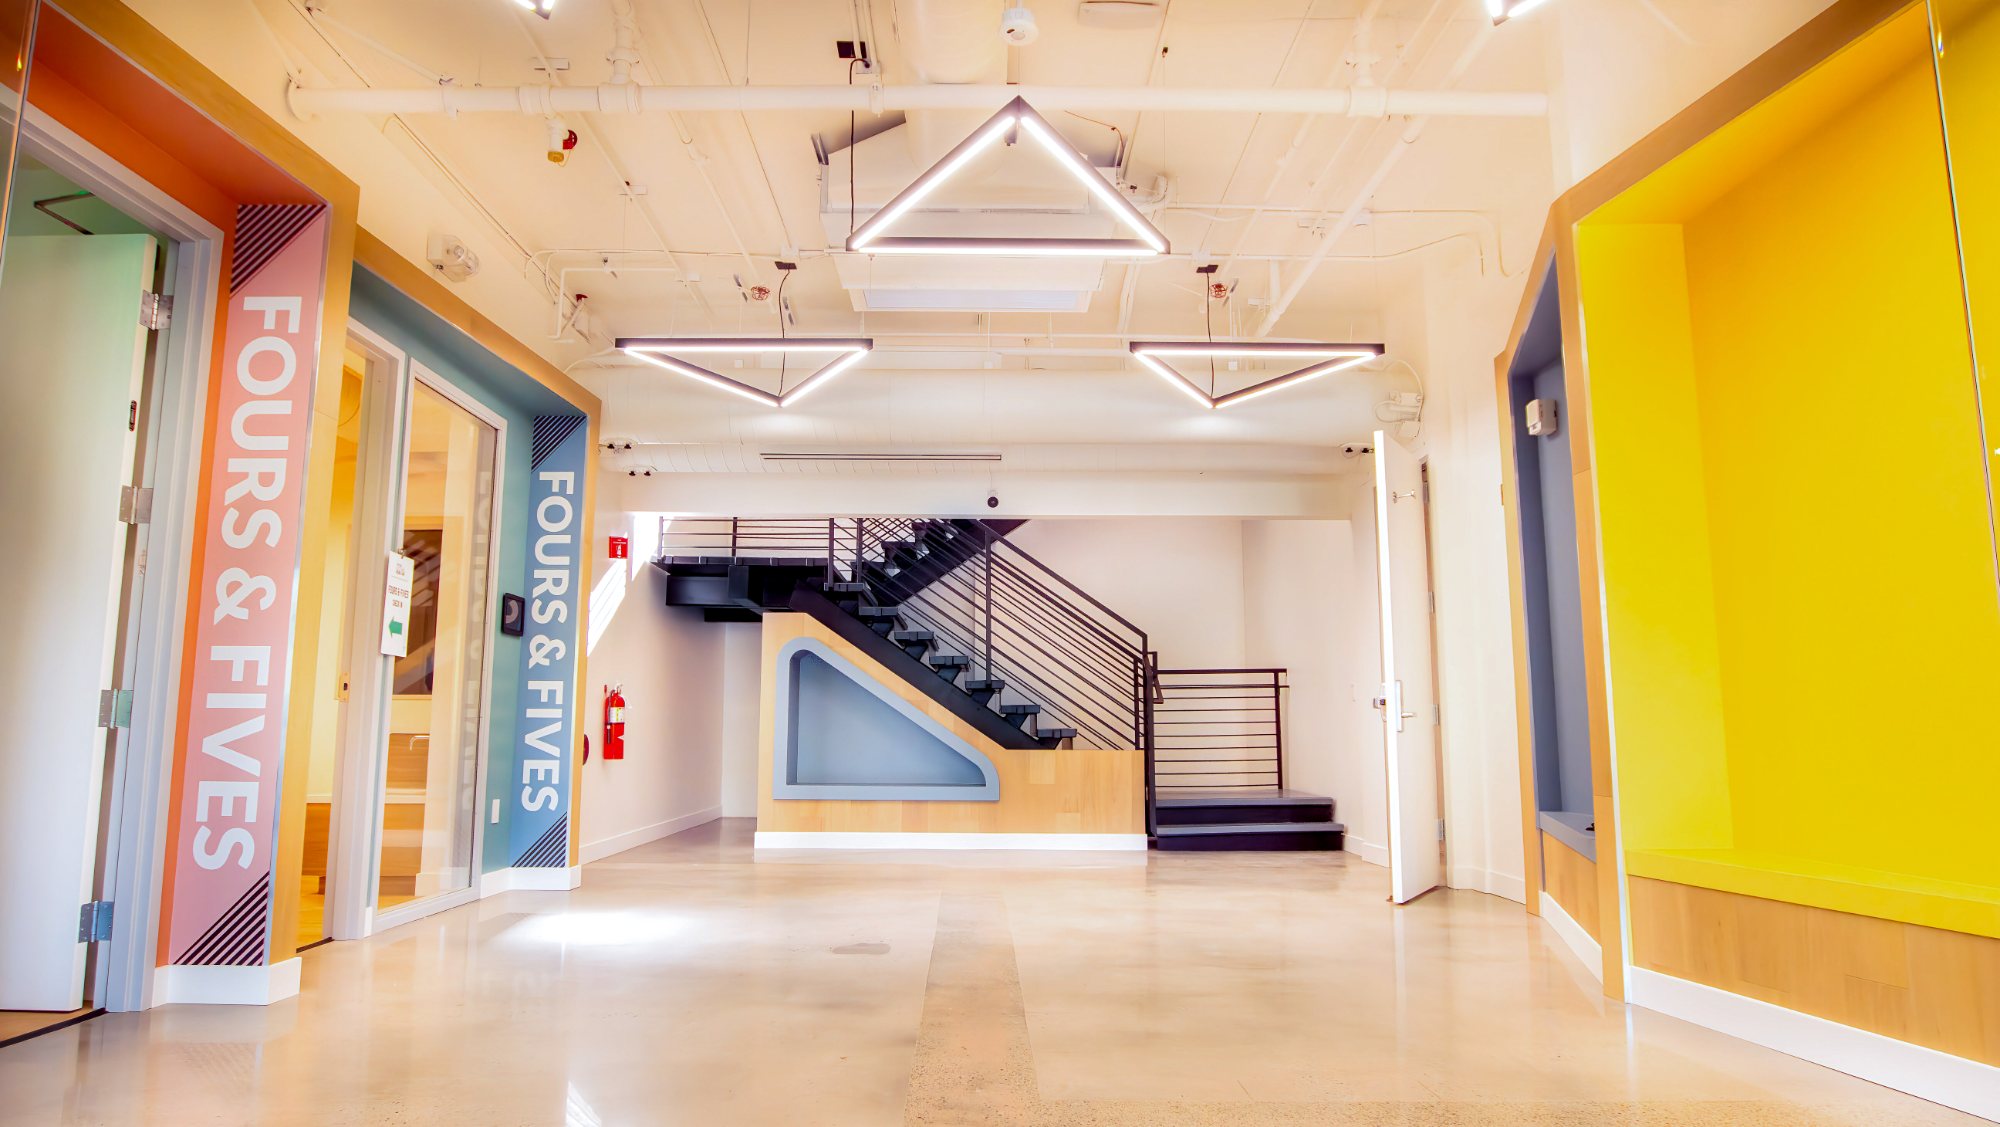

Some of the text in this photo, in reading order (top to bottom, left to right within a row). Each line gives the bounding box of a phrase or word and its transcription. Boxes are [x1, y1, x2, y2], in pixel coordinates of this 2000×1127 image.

[192, 296, 302, 871] FOURS & FIVES
[521, 471, 575, 812] FOURS & FIVES
